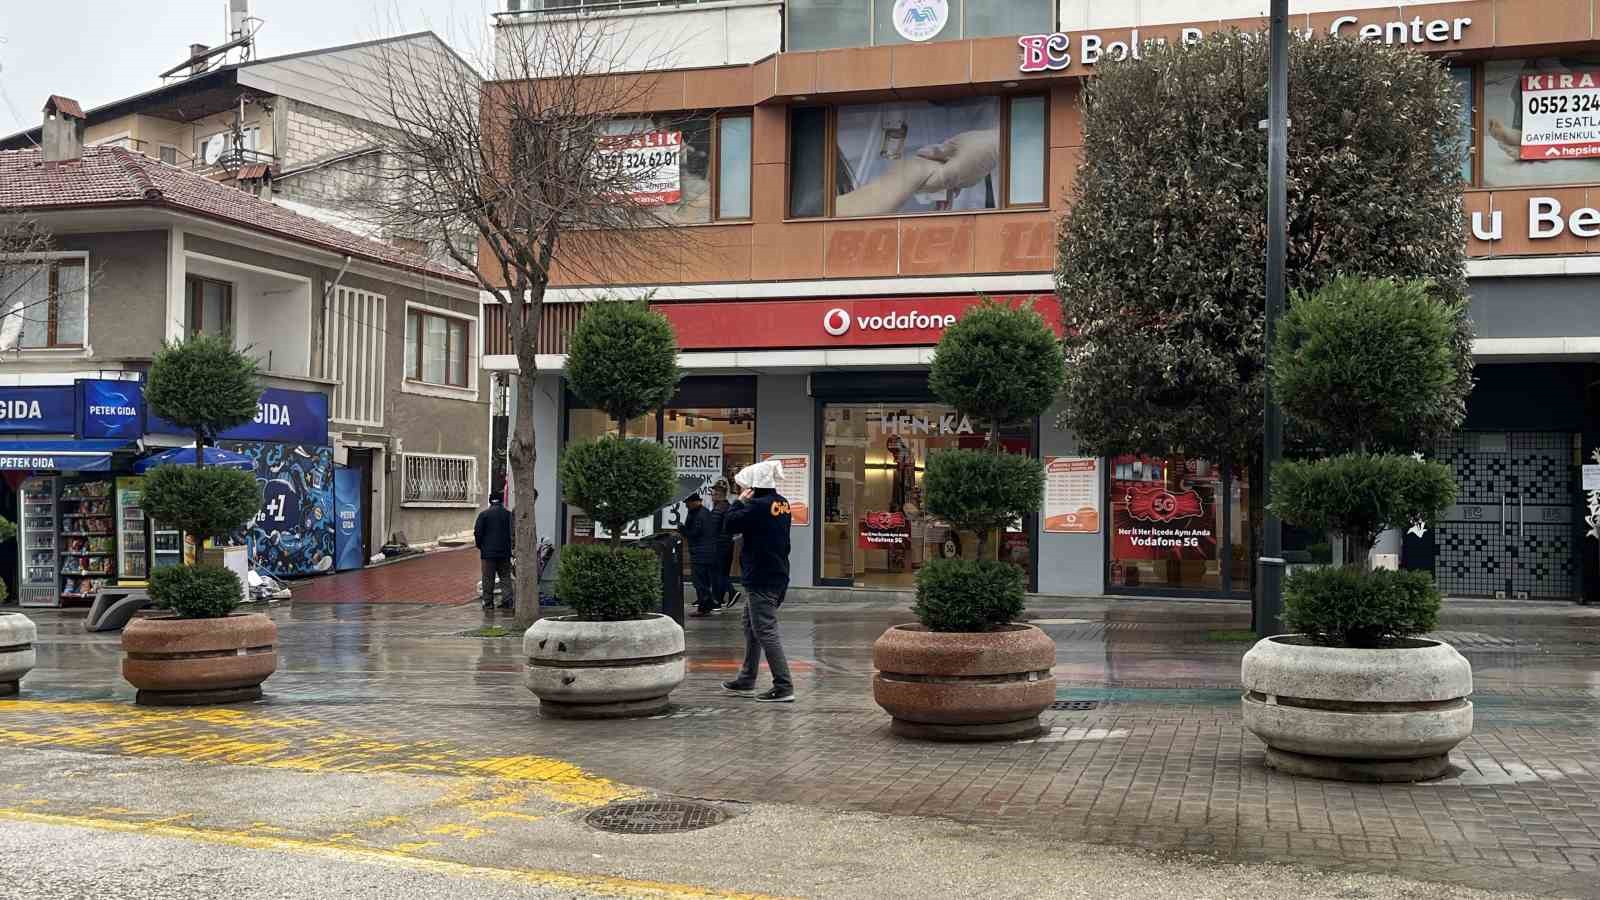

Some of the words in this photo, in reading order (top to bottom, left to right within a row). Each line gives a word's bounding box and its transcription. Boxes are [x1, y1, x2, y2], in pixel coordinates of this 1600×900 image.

[1081, 29, 1168, 64] Bol
[1330, 15, 1472, 45] Center
[1529, 95, 1568, 115] 0552
[1572, 94, 1600, 113] 324
[1526, 131, 1595, 142] GAYRİMENKUL
[626, 152, 647, 168] 324
[649, 152, 662, 167] 62
[1529, 197, 1600, 240] Be
[857, 310, 957, 331] vodafone
[90, 405, 115, 416] PETEK
[117, 406, 136, 416] GIDA
[1, 457, 29, 468] PETEK
[32, 457, 55, 469] GIDA
[1154, 498, 1174, 512] 5G
[1191, 528, 1211, 537] Anda
[1130, 536, 1182, 547] Vodafone
[1183, 537, 1199, 547] 5G
